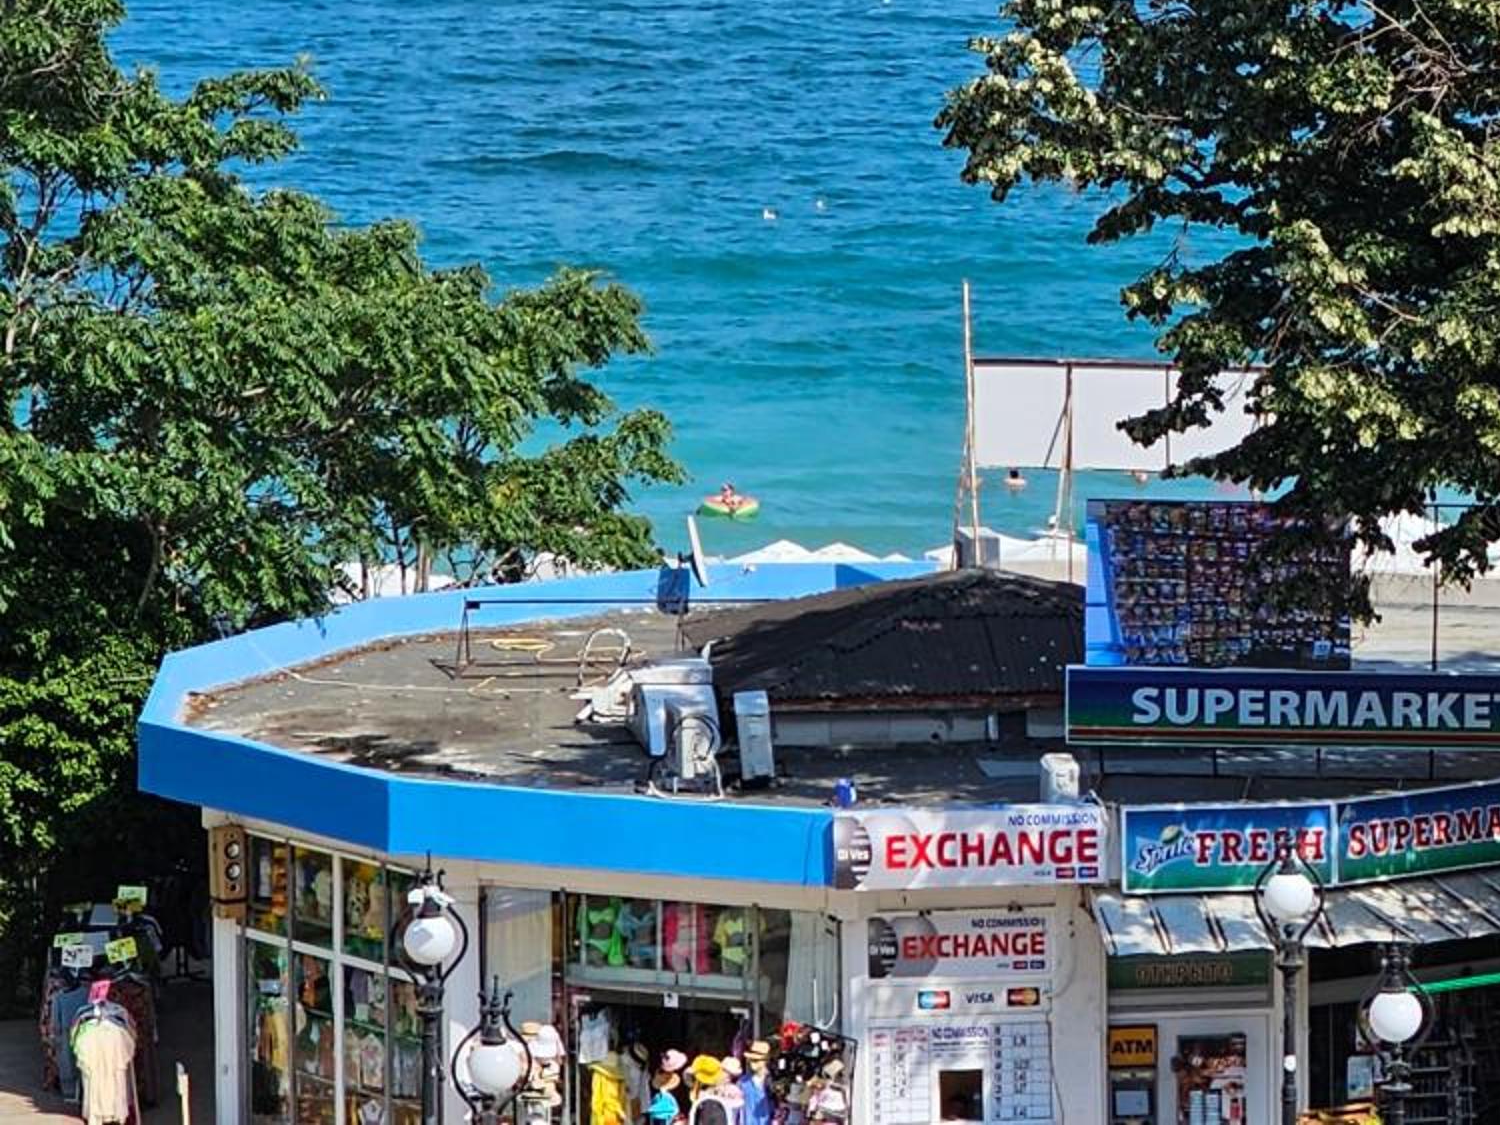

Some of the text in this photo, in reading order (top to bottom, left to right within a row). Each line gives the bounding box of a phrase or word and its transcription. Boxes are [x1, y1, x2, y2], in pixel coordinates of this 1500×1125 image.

[884, 829, 1098, 870] EXCHANGE
[902, 932, 1046, 960] EXCHANGE
[965, 992, 994, 1004] VISA
[1111, 1039, 1153, 1054] ATM
